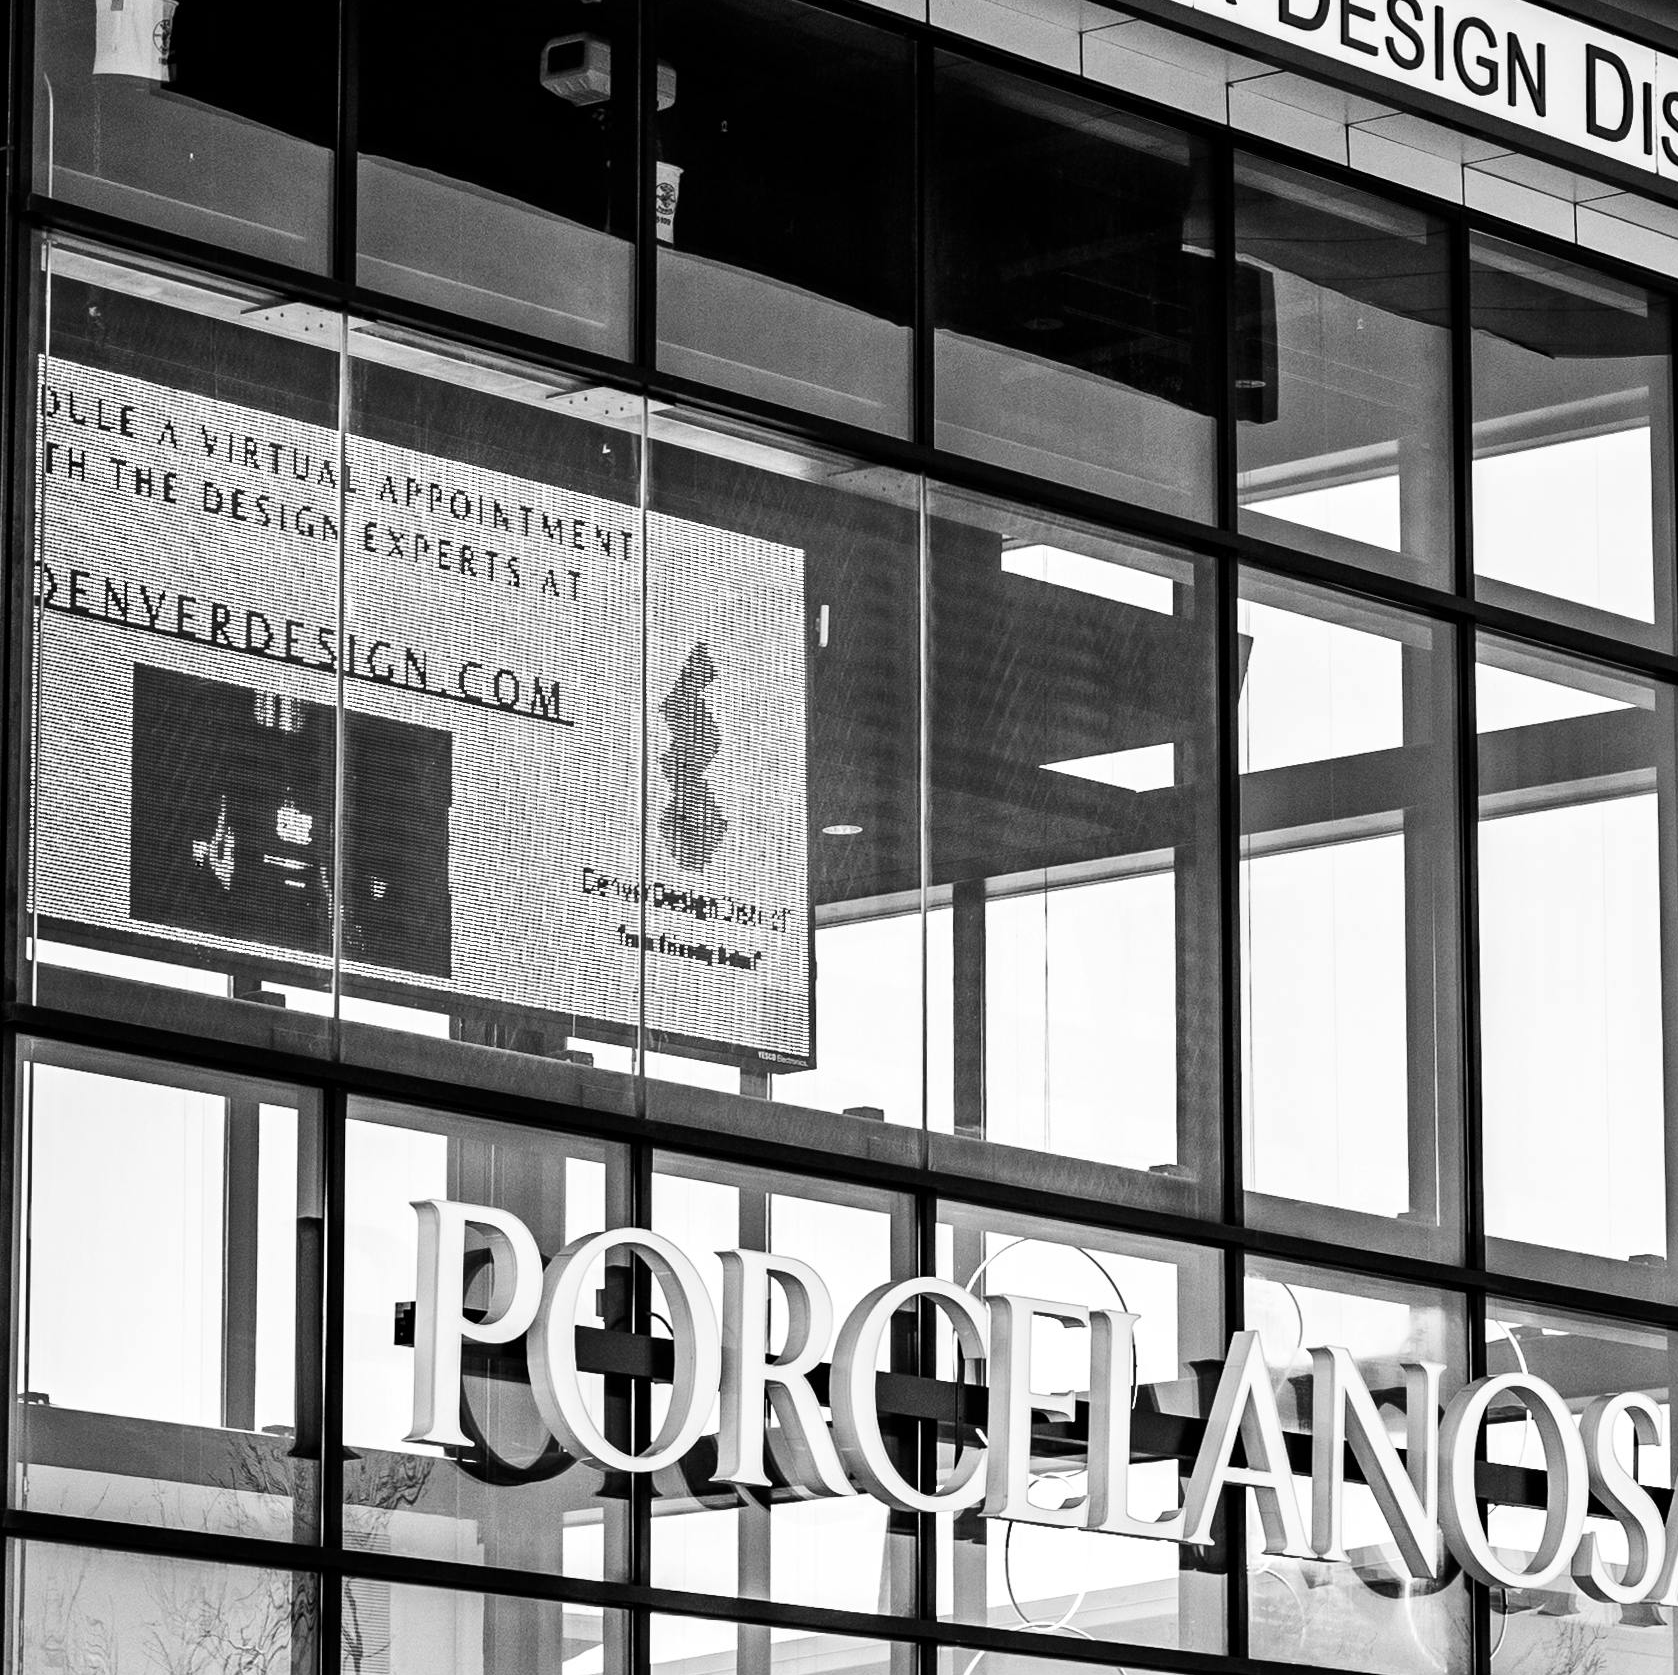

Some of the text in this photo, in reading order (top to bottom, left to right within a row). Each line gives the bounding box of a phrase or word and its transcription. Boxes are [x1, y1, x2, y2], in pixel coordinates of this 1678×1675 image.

[110, 457, 177, 504] THE
[204, 481, 338, 542] DESIGN
[364, 522, 520, 588] EXPERTS
[542, 569, 581, 601] AT
[158, 419, 177, 448] A
[202, 425, 356, 493] VIRTUAL
[380, 476, 633, 560] APPOINTMENT
